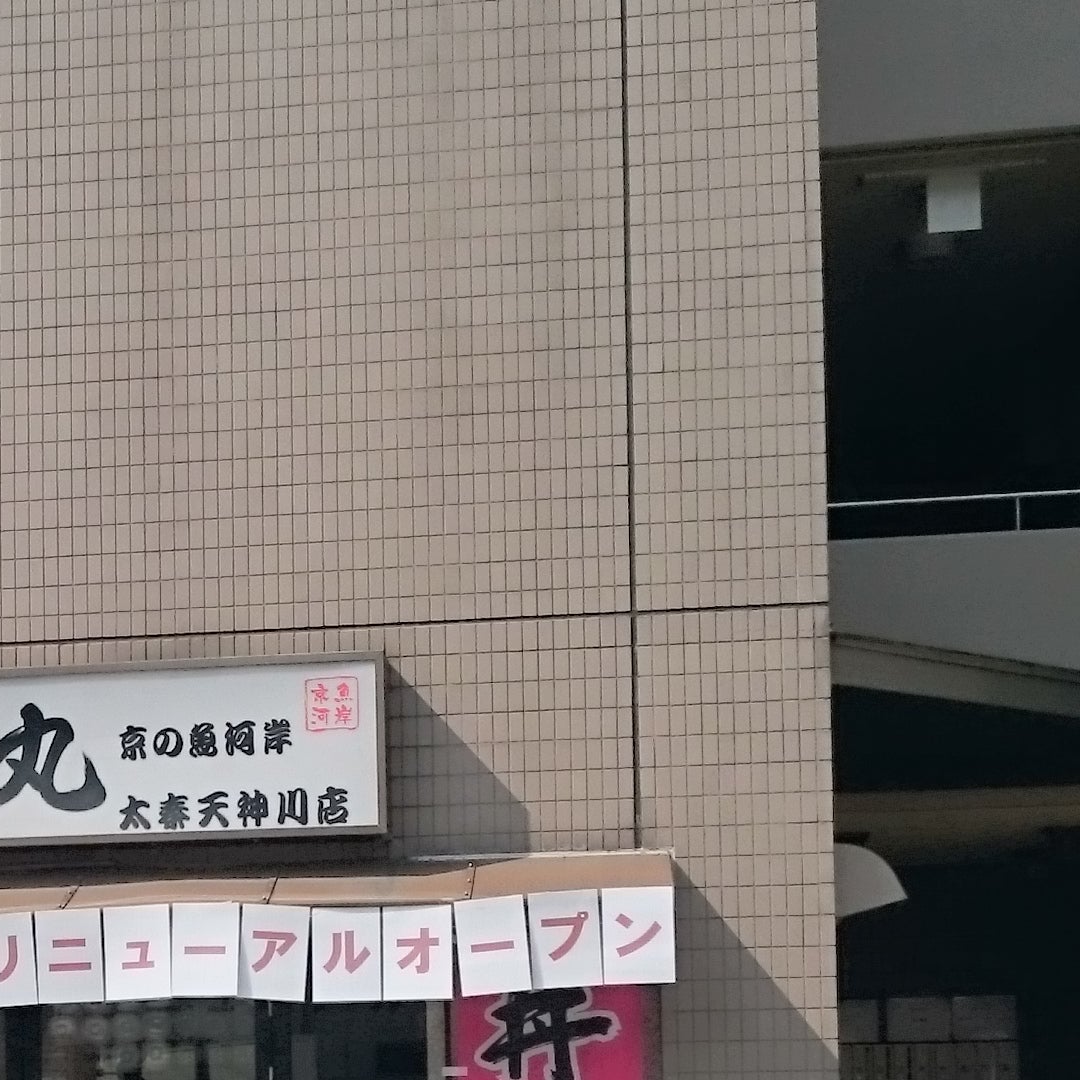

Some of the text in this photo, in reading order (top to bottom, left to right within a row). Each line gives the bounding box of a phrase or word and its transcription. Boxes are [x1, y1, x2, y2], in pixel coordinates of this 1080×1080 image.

[119, 719, 293, 761] 京の魚河岸
[119, 787, 350, 833] 太秦天神川店
